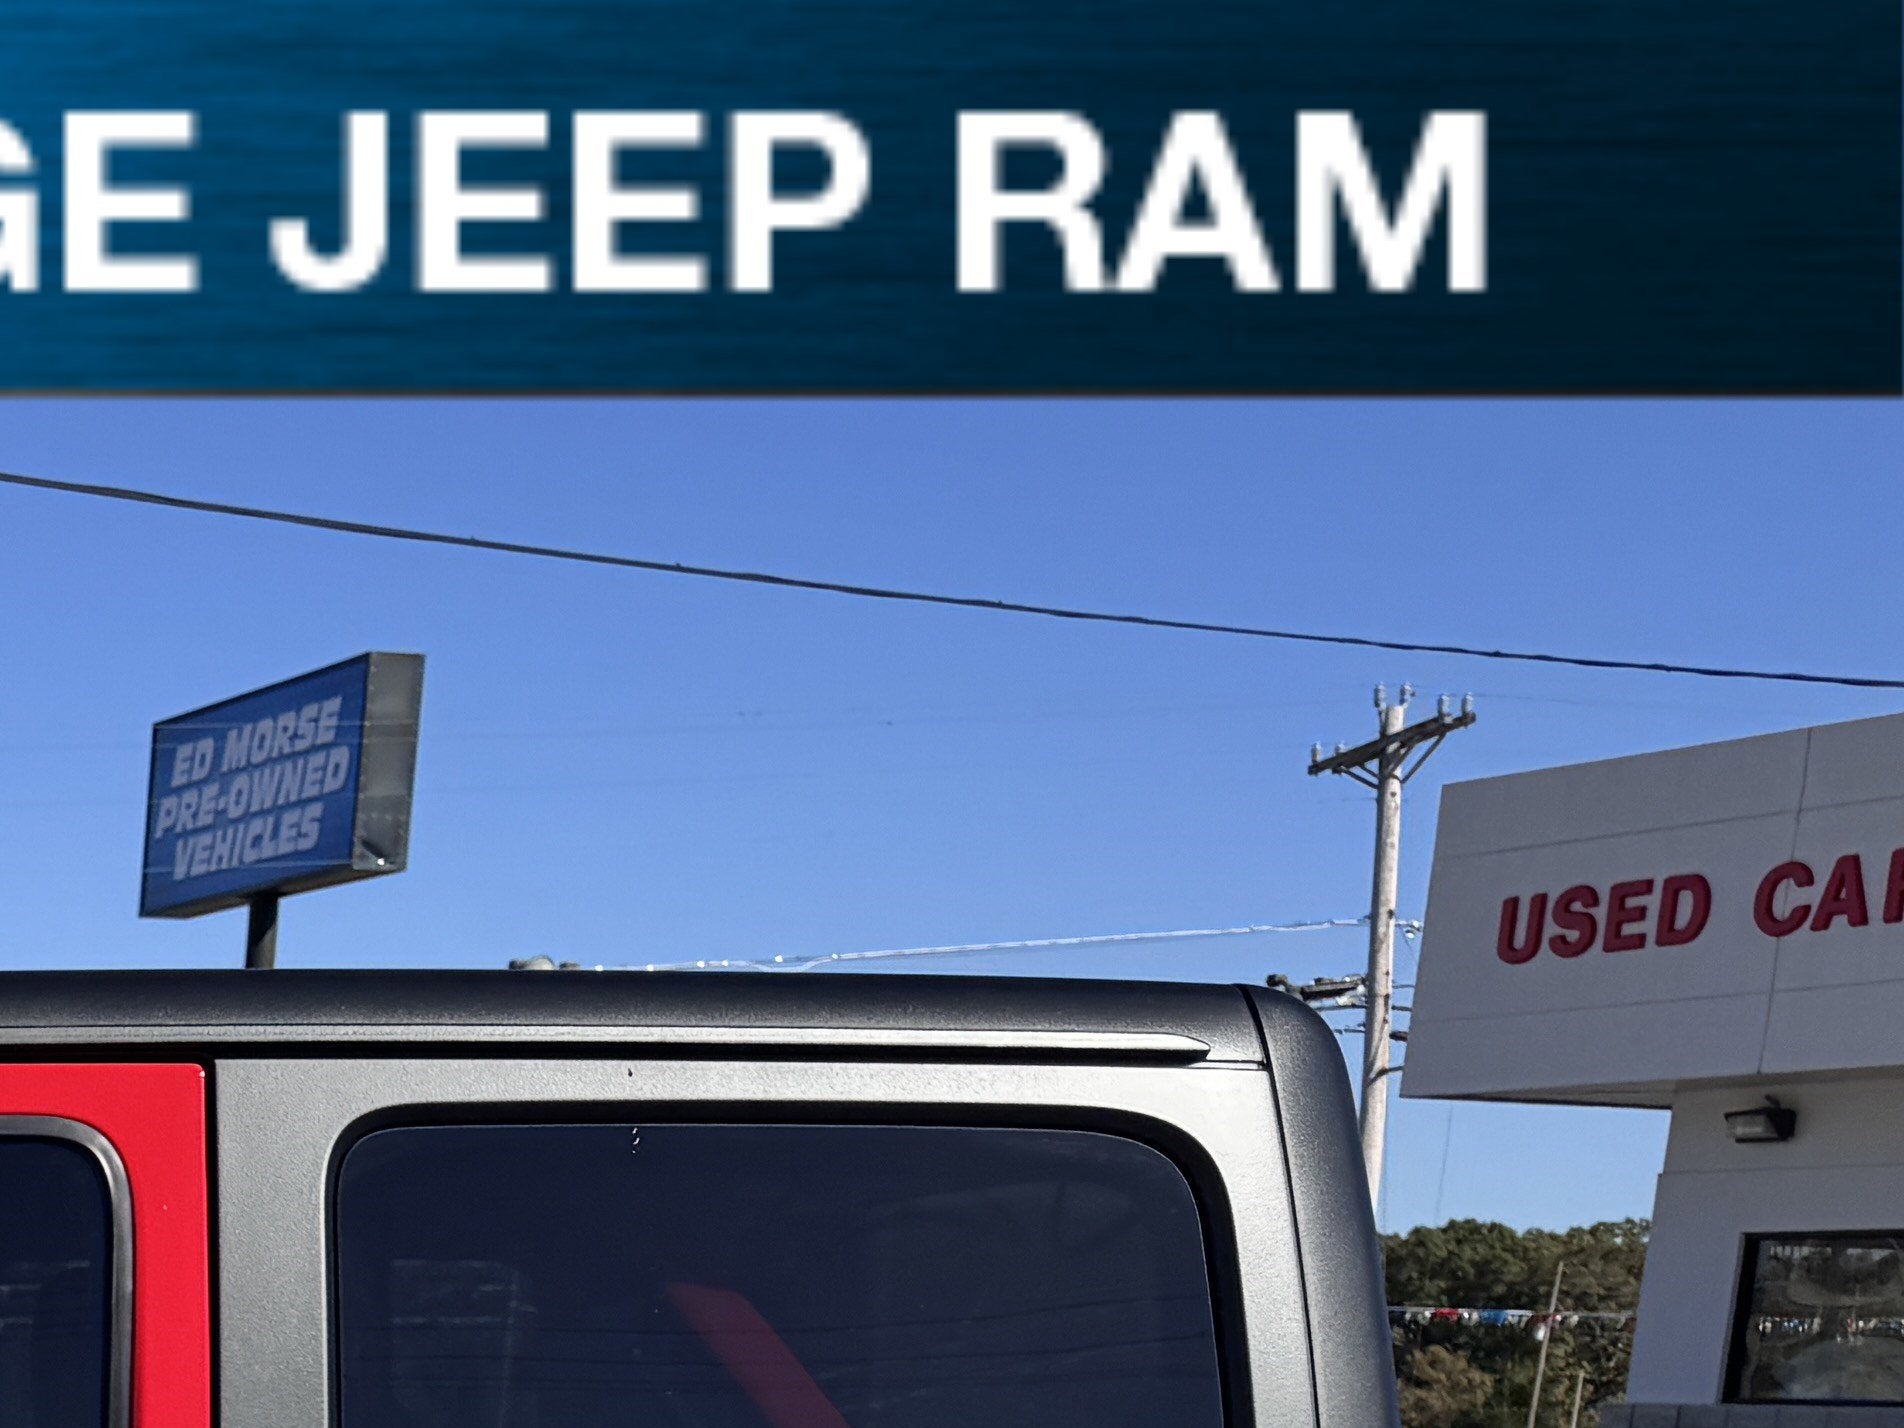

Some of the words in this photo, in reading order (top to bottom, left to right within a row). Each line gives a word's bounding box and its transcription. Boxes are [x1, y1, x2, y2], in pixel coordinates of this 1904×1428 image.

[171, 738, 214, 788] ED
[223, 698, 343, 773] MORSE
[155, 746, 351, 839] PRE-OWNED
[173, 803, 325, 881] VEHICLES
[1496, 873, 1712, 965] USED
